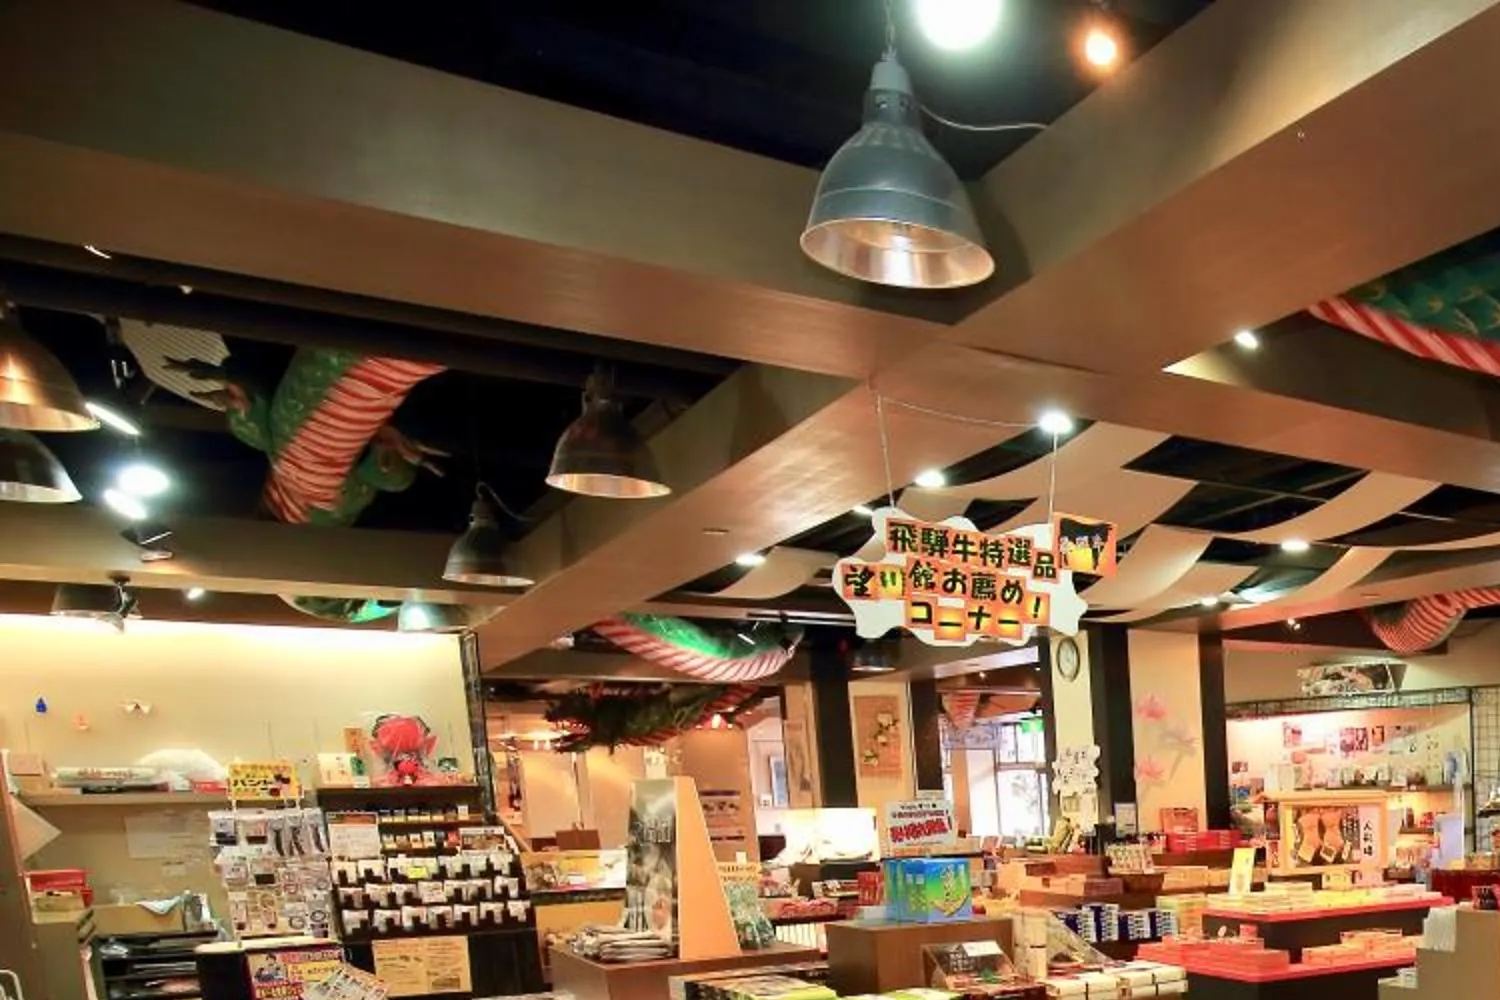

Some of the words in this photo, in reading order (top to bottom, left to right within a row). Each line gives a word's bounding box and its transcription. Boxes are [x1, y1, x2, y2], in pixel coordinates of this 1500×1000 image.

[889, 521, 1058, 580] 飛騨牛特選品
